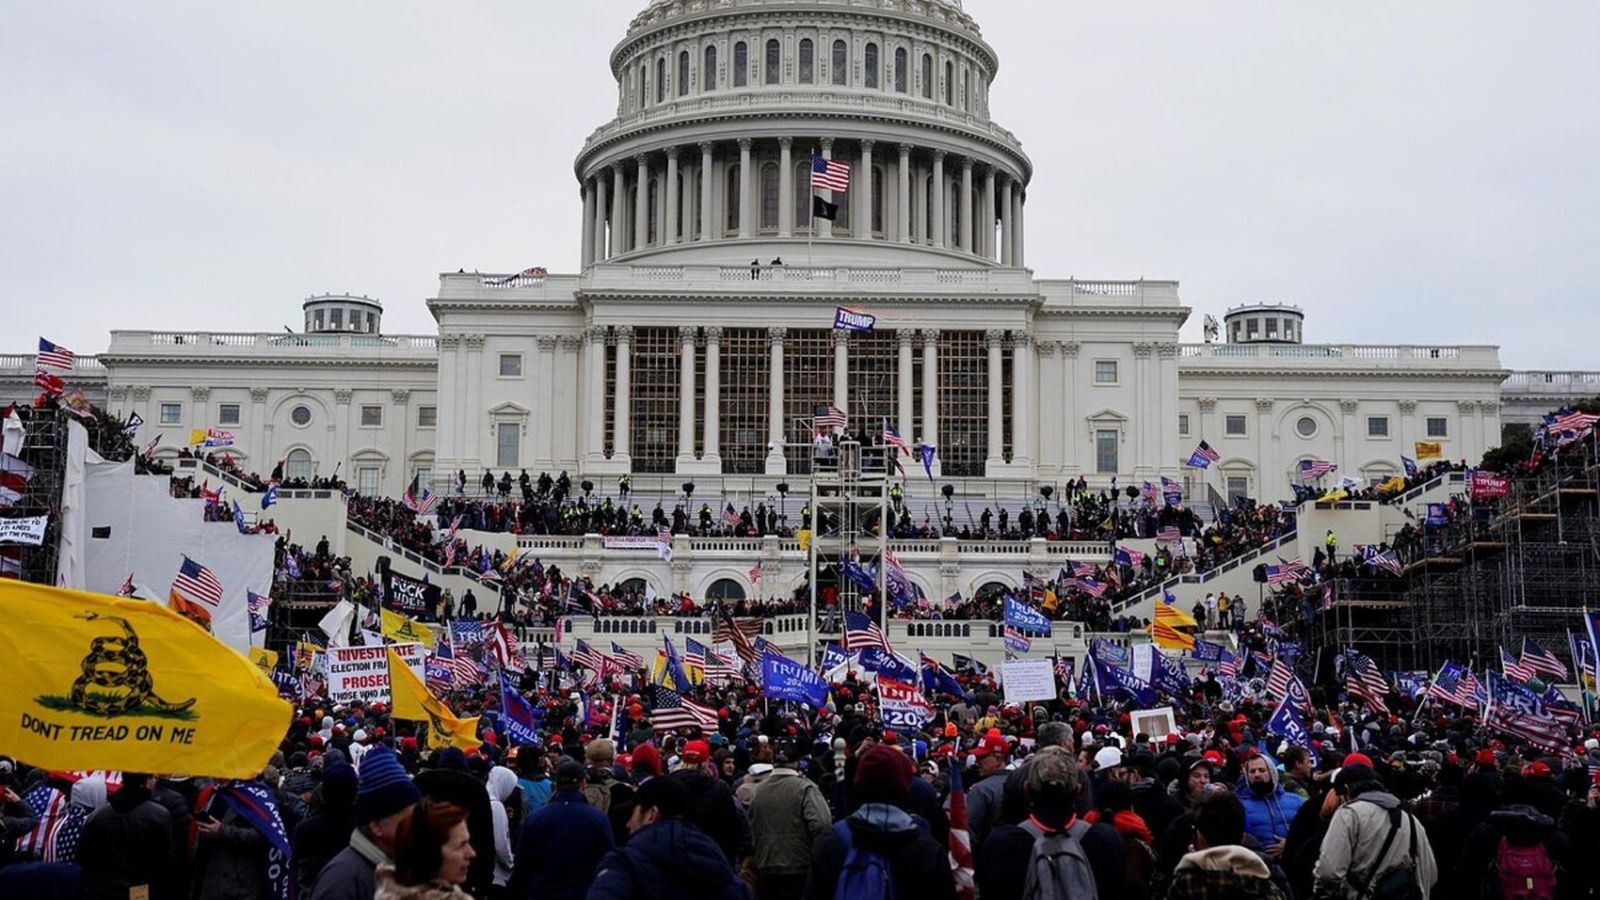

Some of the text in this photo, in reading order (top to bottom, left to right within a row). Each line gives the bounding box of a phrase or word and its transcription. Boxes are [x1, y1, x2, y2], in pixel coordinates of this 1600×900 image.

[839, 309, 873, 328] TRUMP
[1475, 478, 1506, 487] TRUMP
[391, 576, 425, 599] FUCK
[457, 630, 486, 642] TRU
[337, 644, 414, 662] INVESTIATE
[331, 661, 370, 673] ELECTION
[342, 674, 389, 690] PROSEC
[332, 688, 390, 701] THOSE WHO AR
[21, 713, 196, 745] DONT TREAD ON ME
